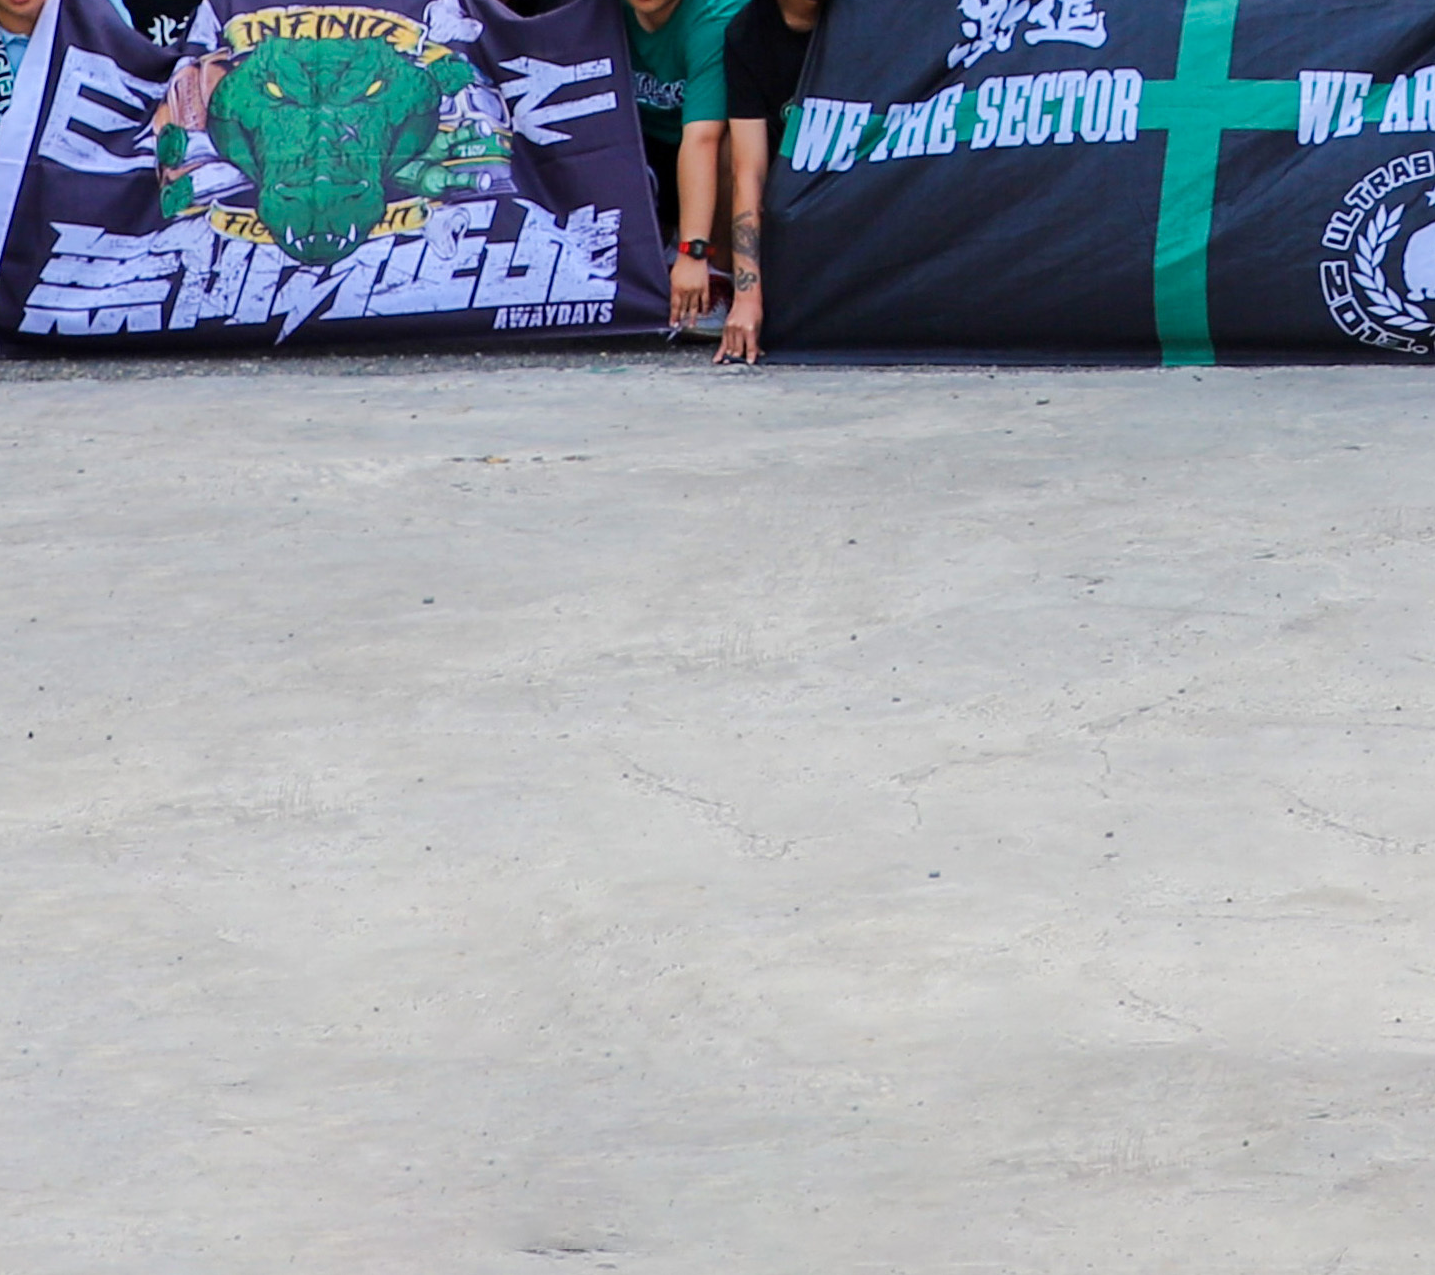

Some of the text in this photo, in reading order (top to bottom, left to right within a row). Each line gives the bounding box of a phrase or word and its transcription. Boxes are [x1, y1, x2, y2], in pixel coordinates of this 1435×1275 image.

[242, 9, 410, 47] INFINITE
[791, 67, 1144, 172] WE THE SECTOR
[1297, 69, 1374, 145] WE
[1321, 150, 1435, 251] ULTRAS
[493, 301, 614, 330] AWAYDAYS
